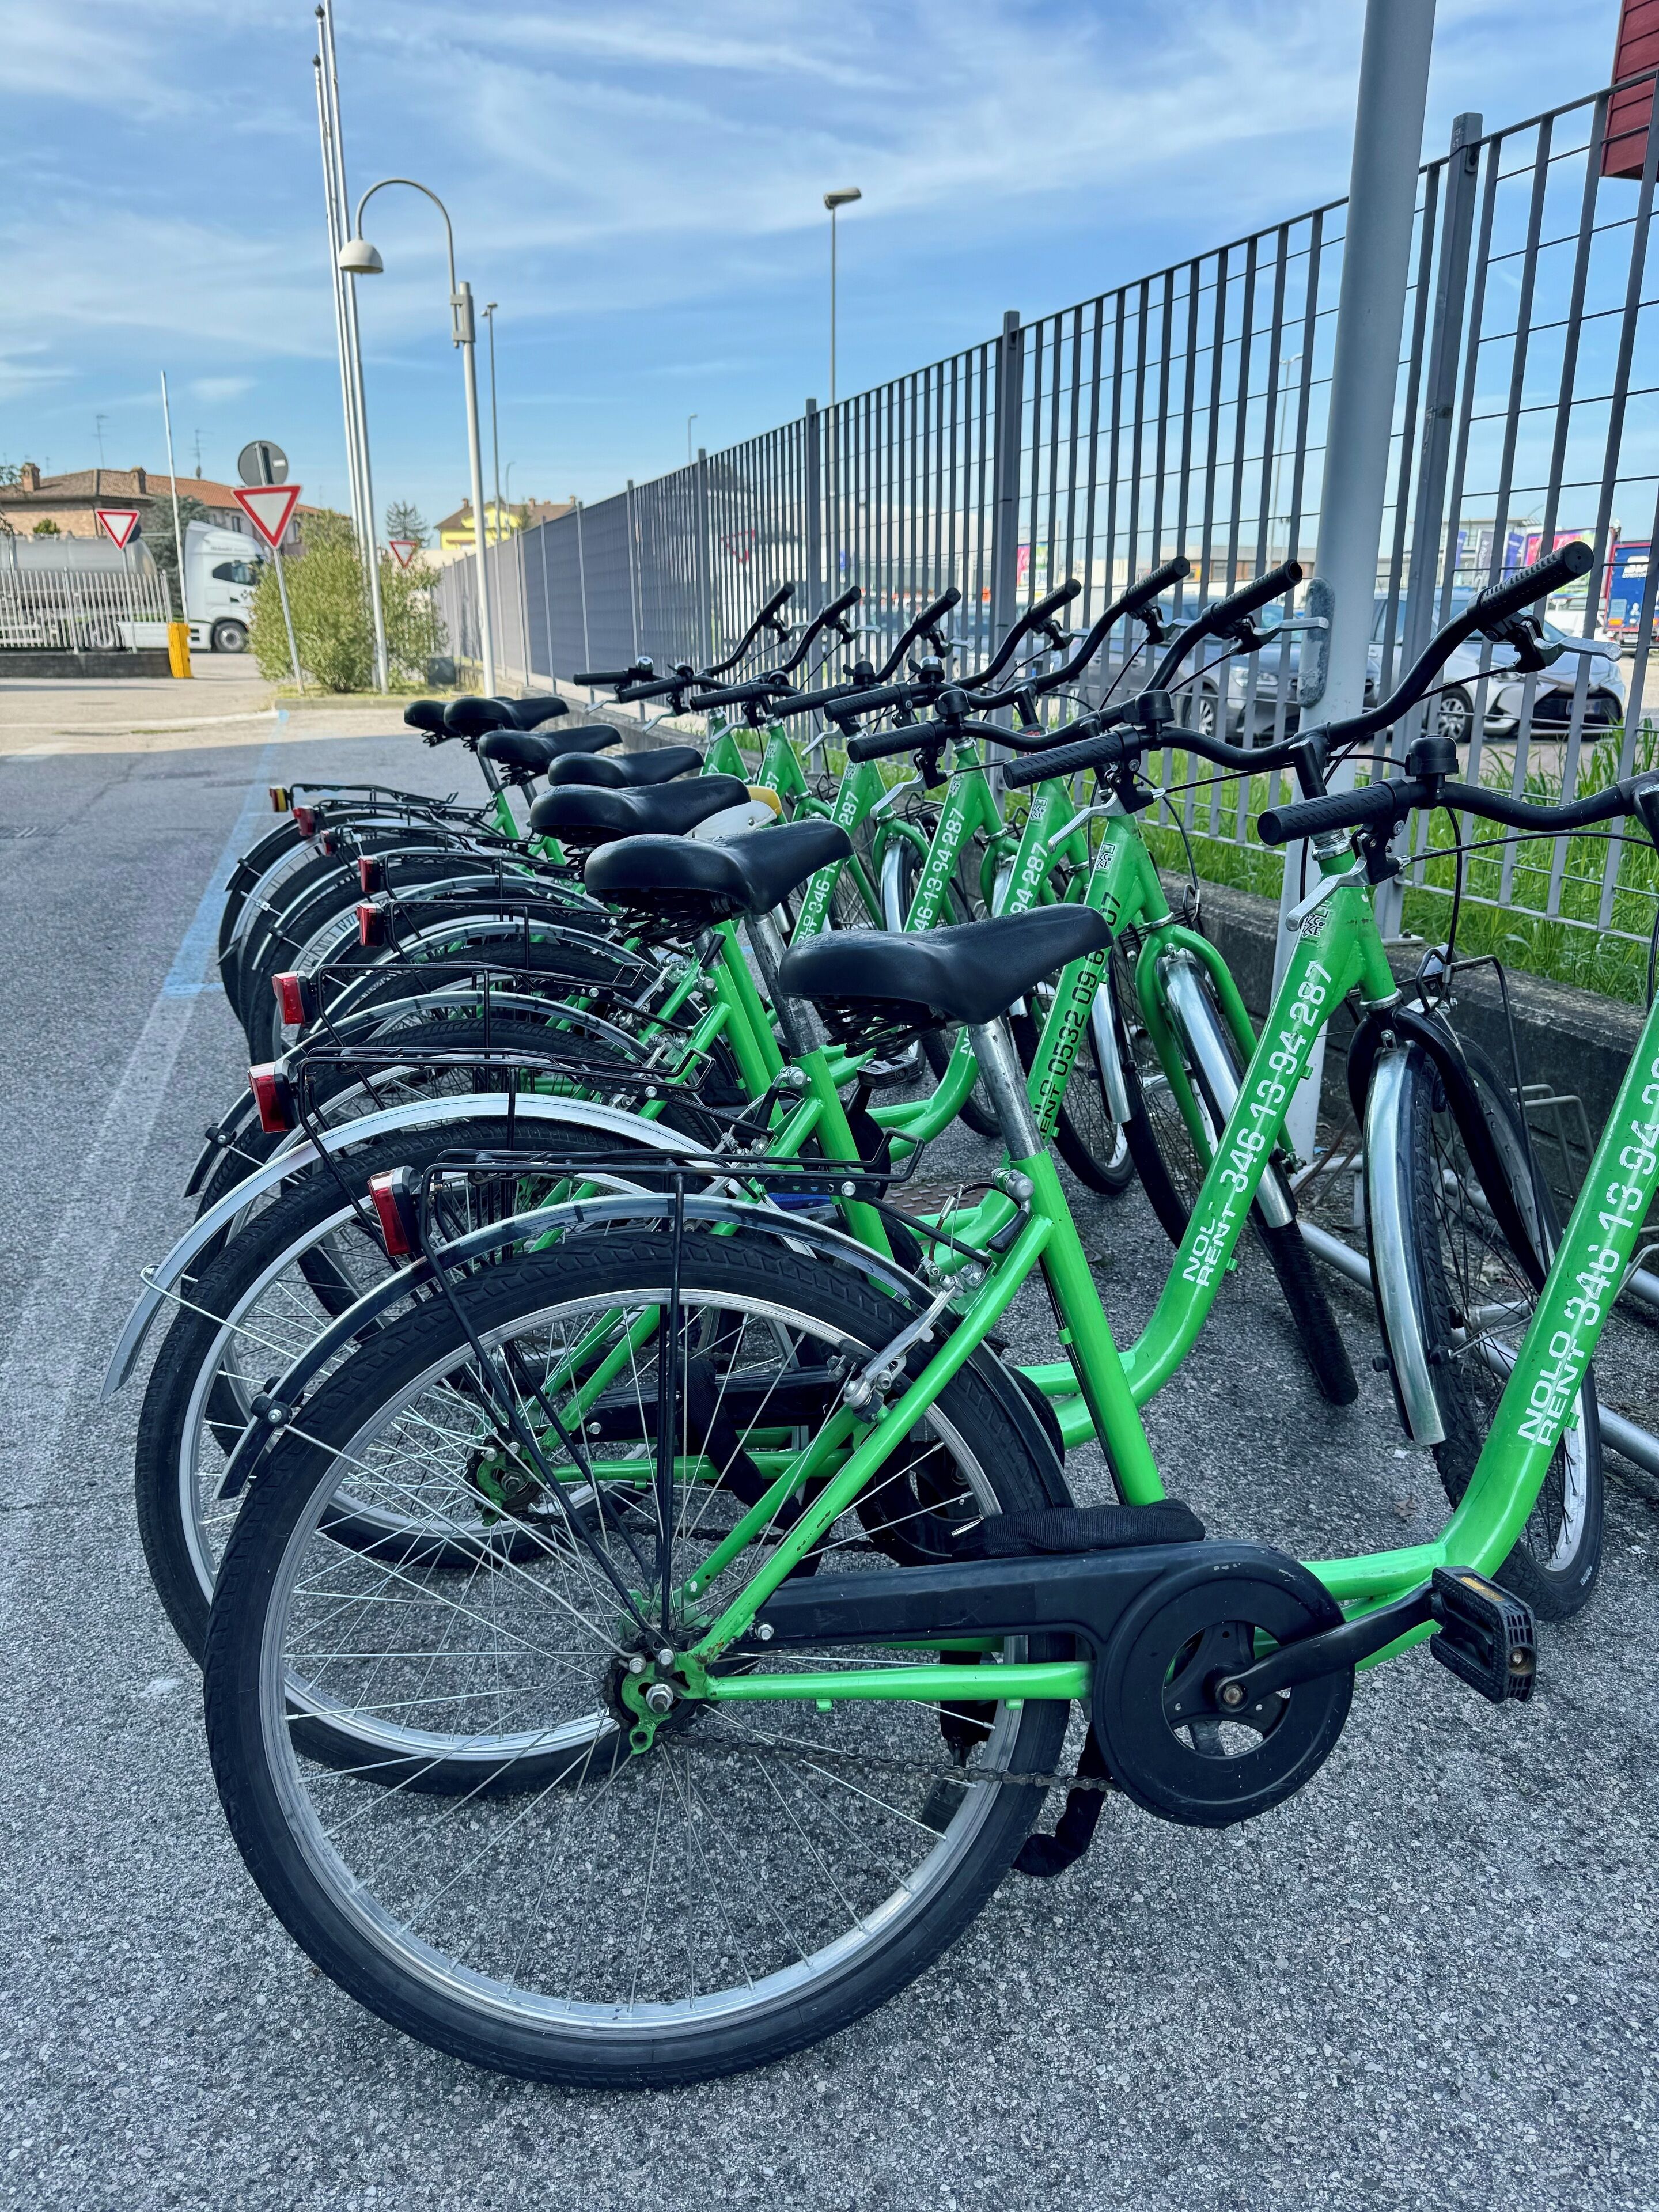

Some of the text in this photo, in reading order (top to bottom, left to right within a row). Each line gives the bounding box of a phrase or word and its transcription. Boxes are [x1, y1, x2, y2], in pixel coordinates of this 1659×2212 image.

[765, 771, 779, 791] 87
[808, 880, 830, 913] 346
[839, 791, 859, 826] 287
[932, 849, 952, 873] 94
[942, 807, 965, 847] 287
[1022, 842, 1047, 886] 287
[911, 906, 933, 932] 46
[923, 877, 942, 900] 13
[1048, 1010, 1085, 1077] 0532
[1072, 970, 1097, 1005] 09
[1040, 1084, 1060, 1138] ENT
[1219, 1128, 1266, 1193] 346
[1249, 1080, 1286, 1118] 13
[1268, 1031, 1306, 1075] 94
[1289, 960, 1332, 1027] 287
[1182, 1202, 1216, 1282] NOL
[1196, 1202, 1236, 1287] RENT
[1564, 1120, 1659, 1326] 346 13 94
[1517, 1331, 1571, 1441] NOLO
[1537, 1339, 1585, 1446] RENT
